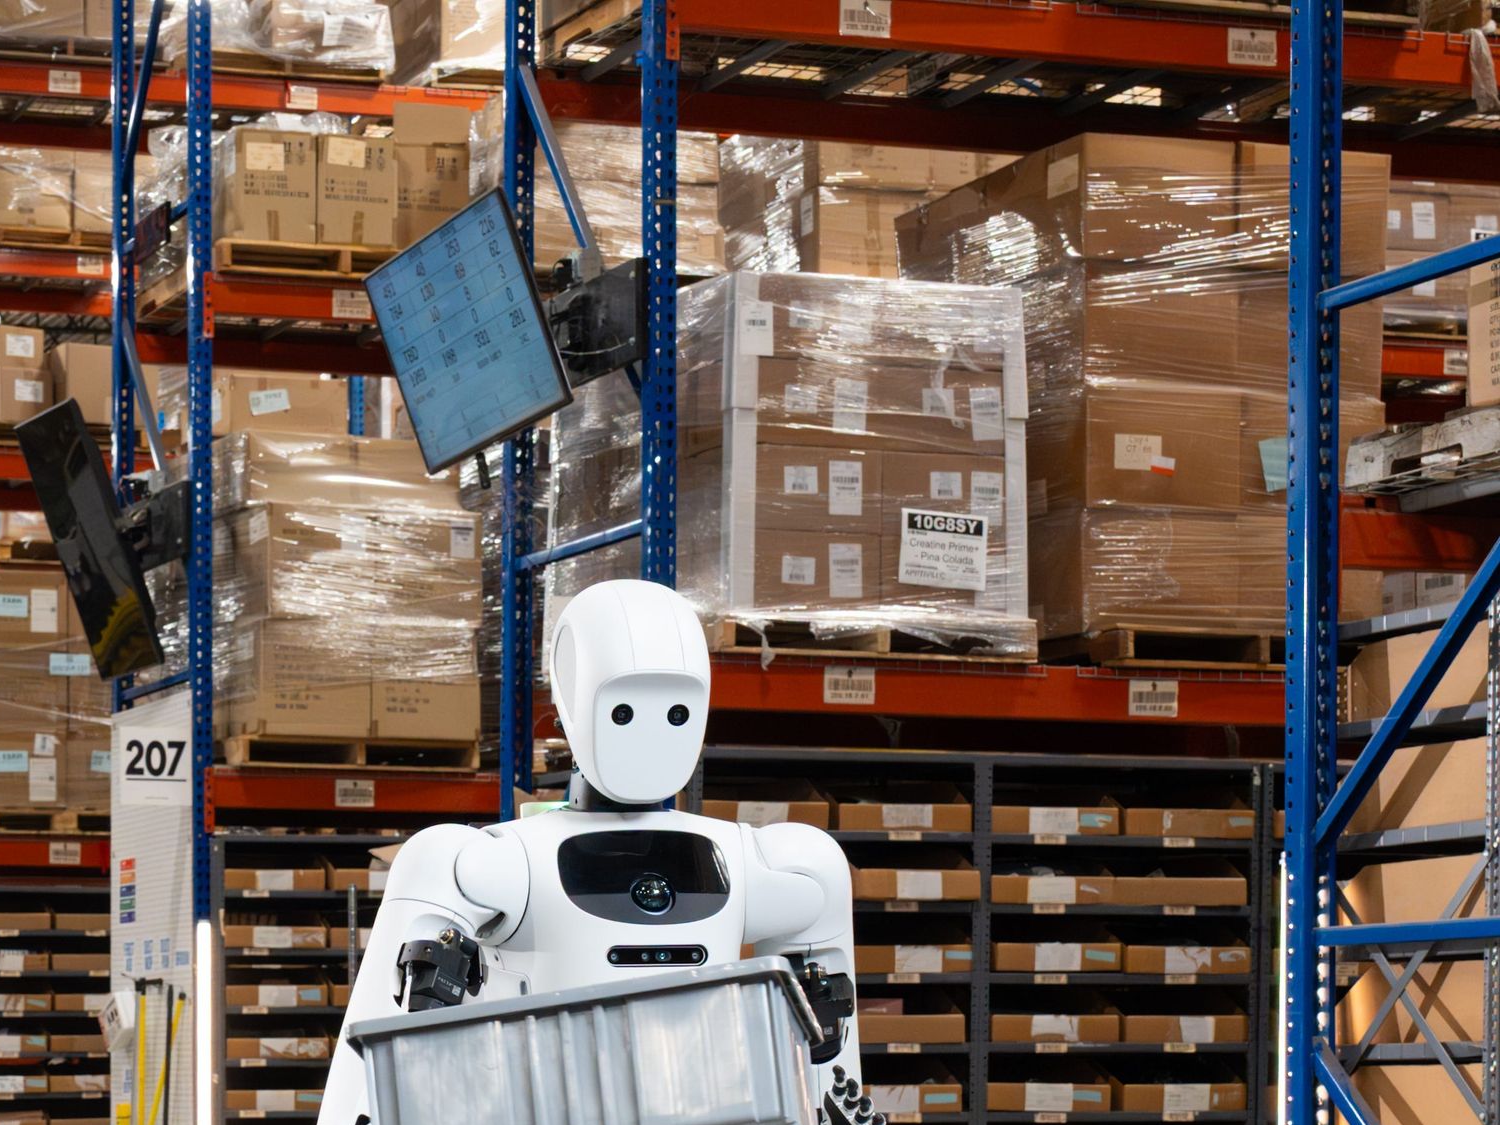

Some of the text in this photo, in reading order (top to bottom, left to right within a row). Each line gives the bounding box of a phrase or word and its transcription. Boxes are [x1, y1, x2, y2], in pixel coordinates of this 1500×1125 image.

[478, 214, 496, 236] 216
[488, 239, 501, 257] 62
[498, 263, 507, 279] 3
[470, 308, 479, 324] 0
[505, 286, 513, 302] 0
[474, 329, 491, 348] 331
[509, 307, 527, 328] 281
[914, 515, 978, 534] 10G8SY
[909, 538, 946, 550] Creatine
[942, 554, 974, 565] Colada
[125, 739, 187, 777] 207
